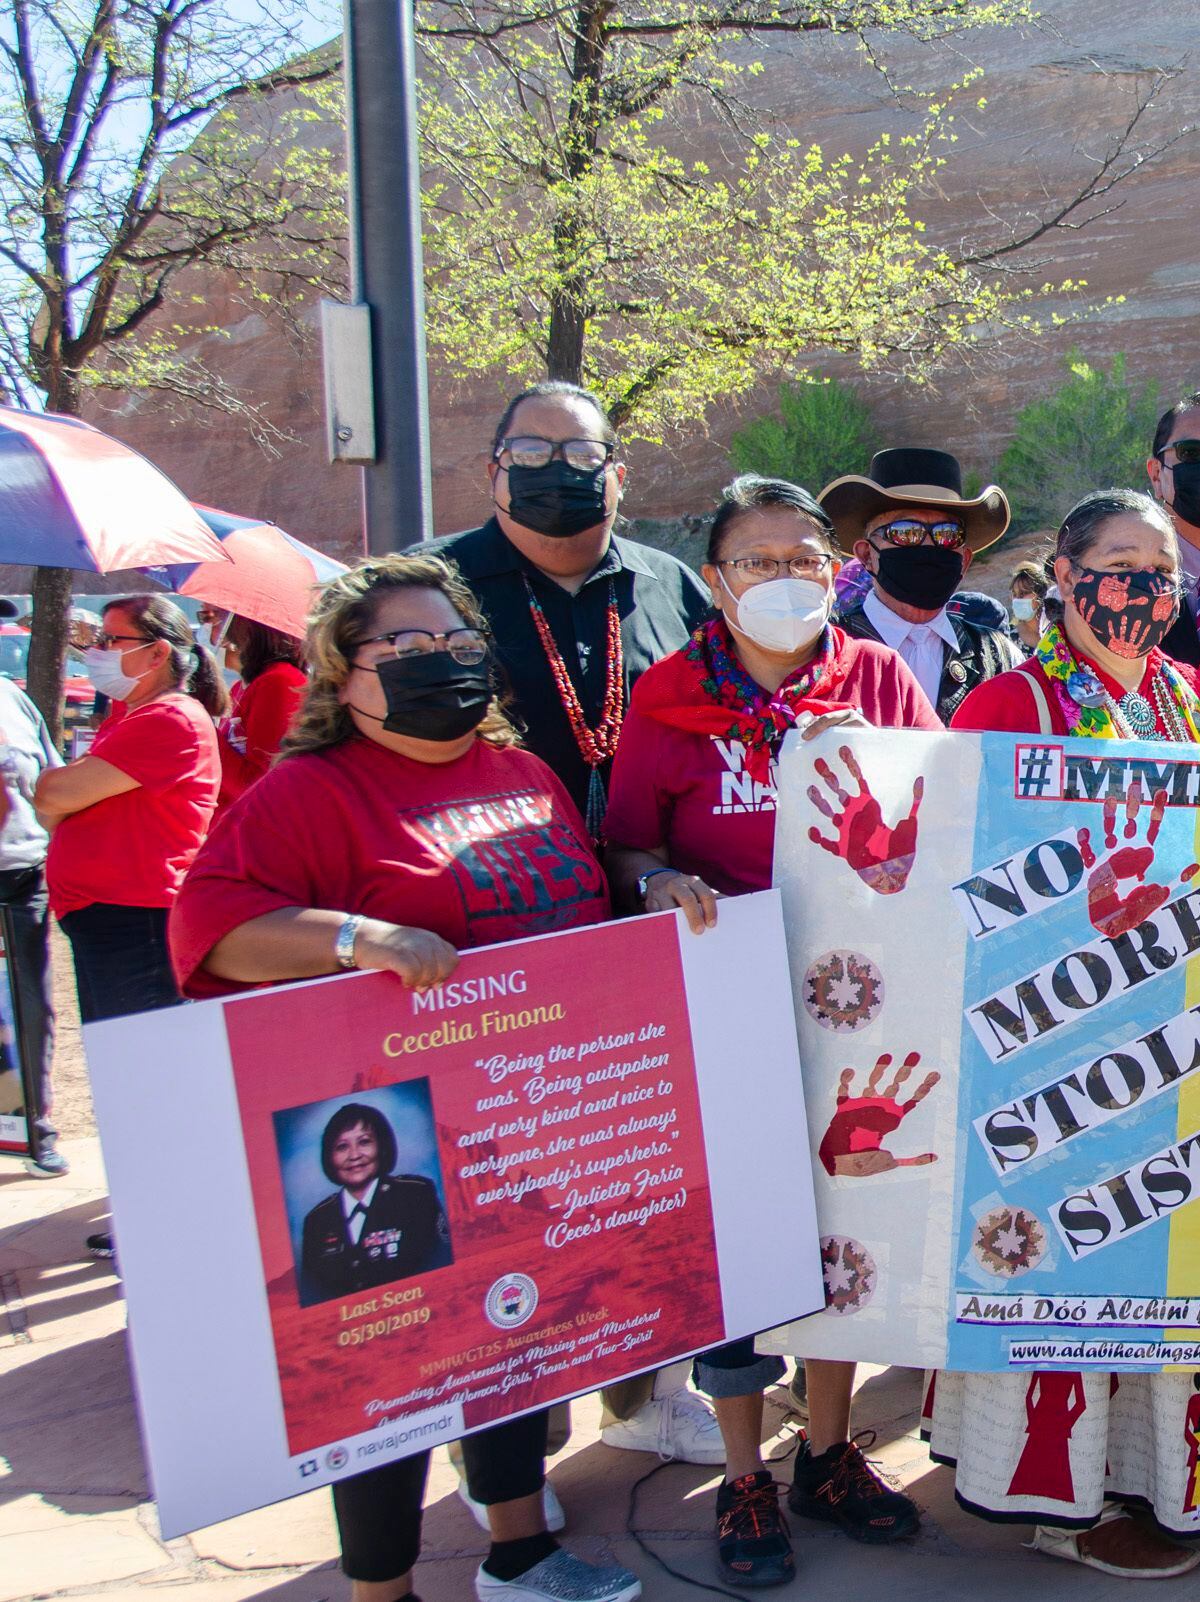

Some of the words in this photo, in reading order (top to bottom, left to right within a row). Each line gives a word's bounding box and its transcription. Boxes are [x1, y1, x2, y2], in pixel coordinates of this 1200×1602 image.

[452, 825, 602, 914] LIVES
[952, 839, 1085, 938] NO
[411, 969, 529, 1016] MISSING
[382, 1020, 478, 1058] Cecelia
[481, 1002, 567, 1037] Finona
[548, 1043, 576, 1064] the
[577, 1030, 635, 1061] person
[637, 1023, 667, 1043] she
[476, 1089, 520, 1113] was.
[522, 1075, 583, 1105] Being
[585, 1052, 670, 1083] outspoken
[457, 1123, 495, 1149] and
[497, 1115, 539, 1139] very
[541, 1101, 581, 1127] kind
[583, 1091, 619, 1115] and
[620, 1084, 655, 1106] nice
[657, 1080, 674, 1096] to
[459, 1146, 545, 1179] everyone,
[545, 1135, 576, 1156] she
[579, 1125, 614, 1147] was
[617, 1108, 678, 1138] always
[476, 1159, 582, 1206] everybody's
[562, 1181, 632, 1220] Julietta
[633, 1164, 685, 1198] Faria
[543, 1211, 603, 1249] (Cece's
[604, 1187, 688, 1230] daughter)
[337, 1306, 432, 1347] 05/30/2019
[339, 1298, 380, 1322] Last
[382, 1286, 425, 1310] Seen
[504, 1317, 575, 1351] Awareness
[574, 1306, 611, 1327] Week
[961, 1296, 1024, 1322] Amá
[1032, 1298, 1088, 1321] Dóó
[364, 1385, 436, 1417] Promoting
[434, 1361, 508, 1397] Awareness
[507, 1353, 525, 1374] for
[525, 1339, 577, 1365] Missing
[577, 1328, 600, 1346] and
[600, 1308, 663, 1338] Murdered
[501, 1371, 534, 1396] Girls,
[533, 1360, 571, 1381] Trans,
[570, 1351, 594, 1367] and
[593, 1328, 655, 1359] Two-Spirit
[356, 1415, 455, 1459] navajommdr
